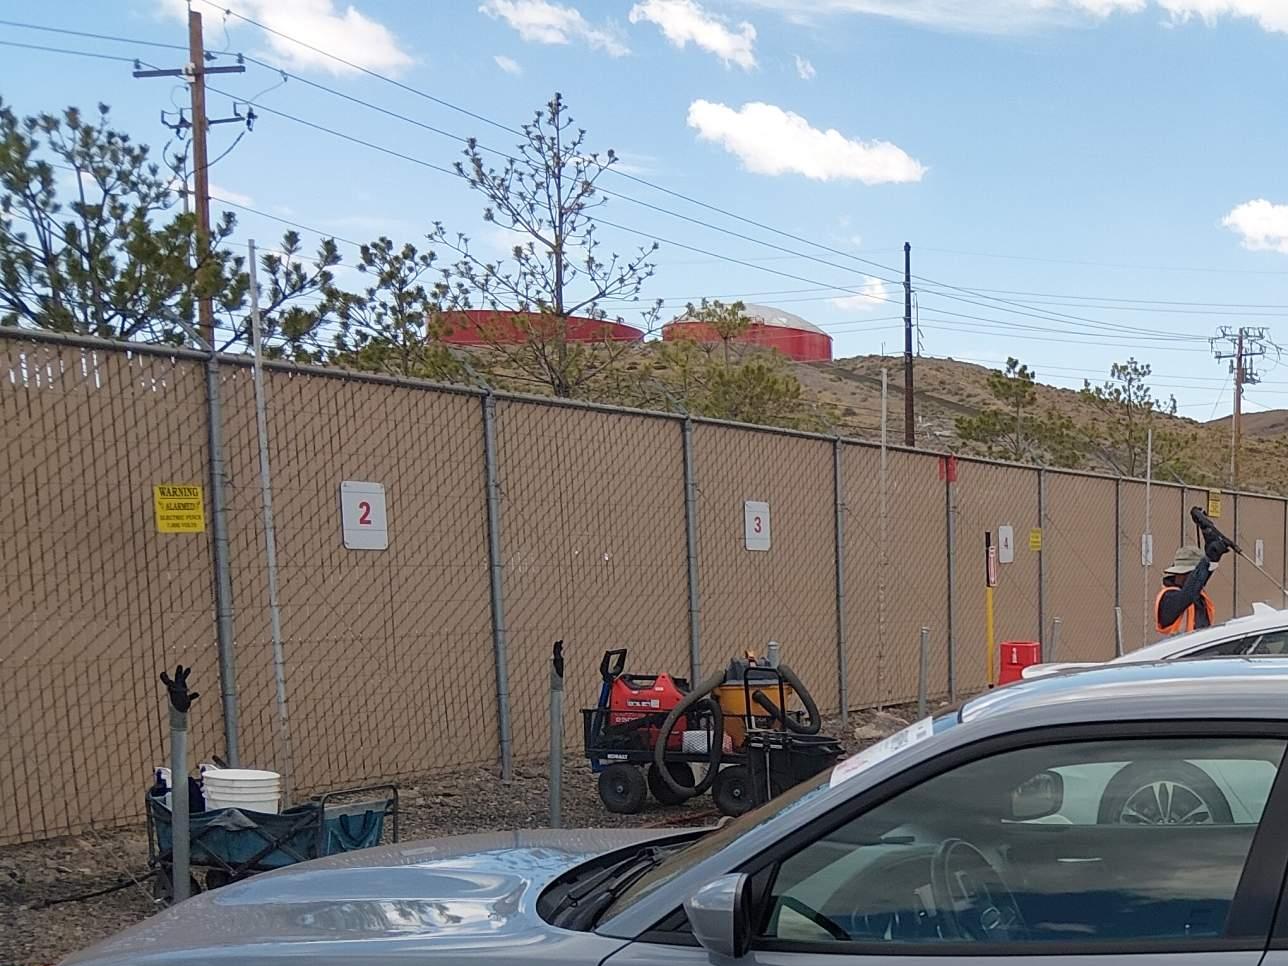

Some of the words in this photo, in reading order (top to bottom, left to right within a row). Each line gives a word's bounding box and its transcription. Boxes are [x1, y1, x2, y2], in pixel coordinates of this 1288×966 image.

[159, 487, 199, 497] WARNING
[166, 502, 196, 511] ALARMED
[359, 501, 372, 525] 2
[754, 516, 762, 533] 3
